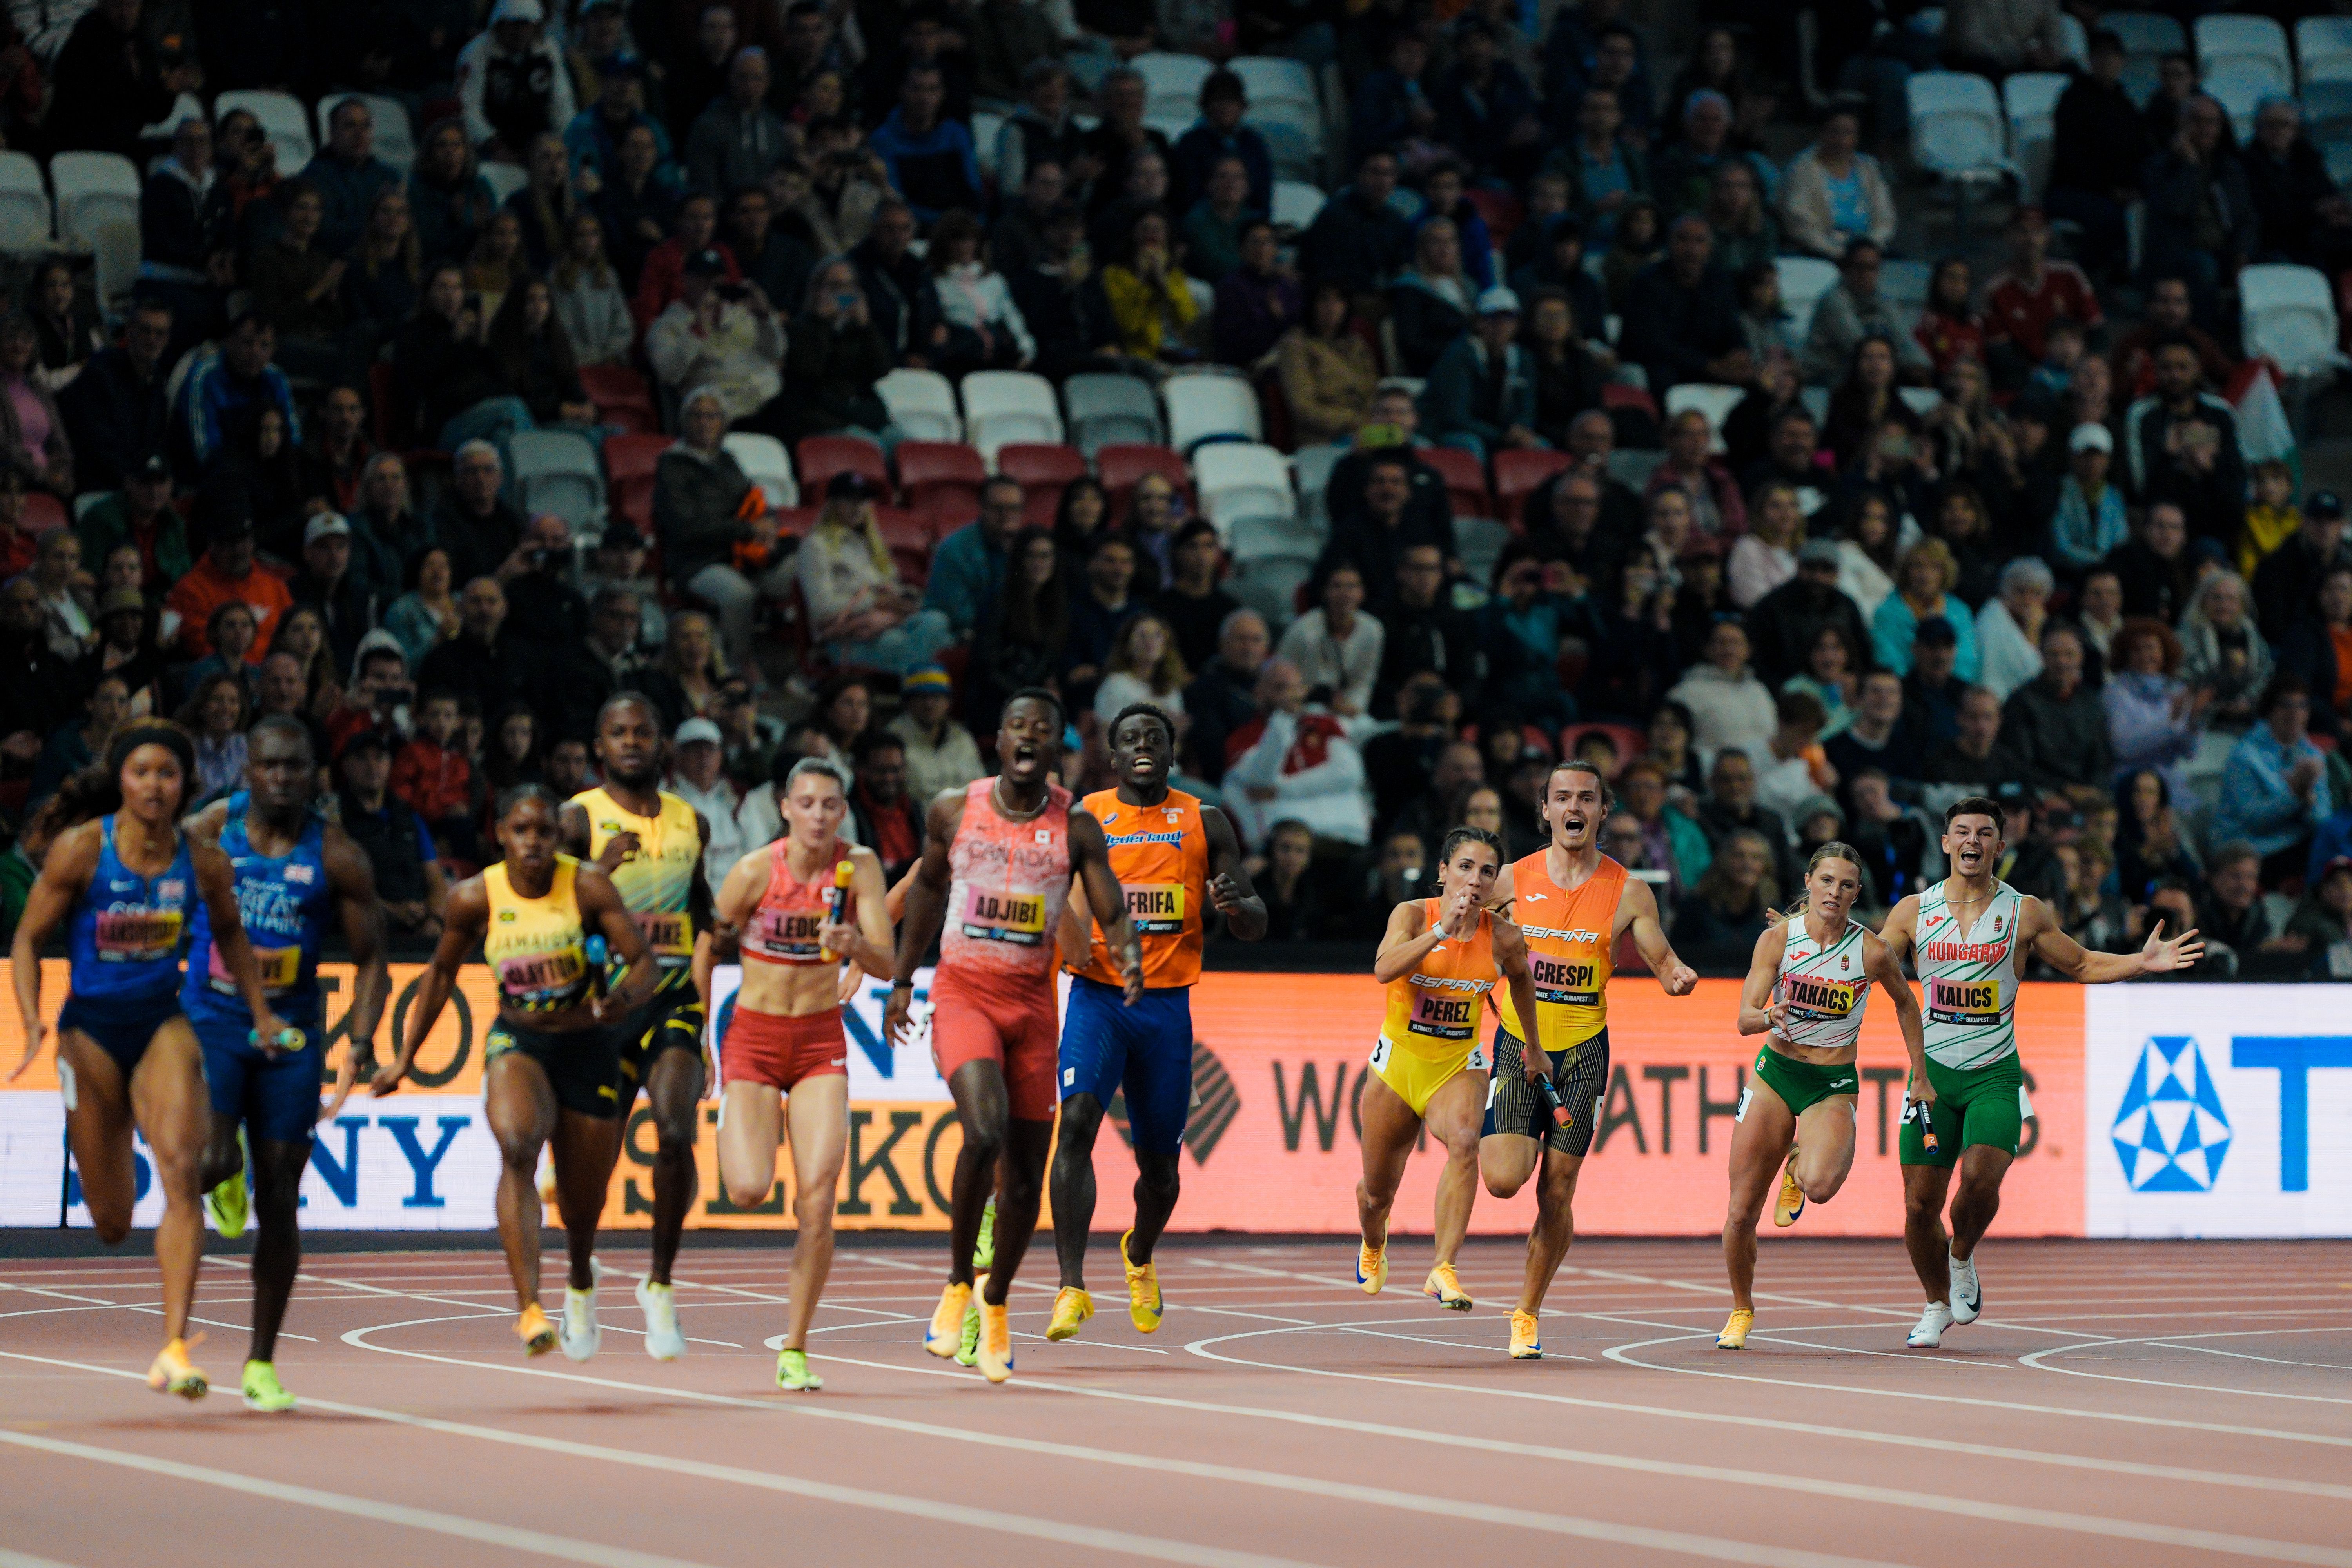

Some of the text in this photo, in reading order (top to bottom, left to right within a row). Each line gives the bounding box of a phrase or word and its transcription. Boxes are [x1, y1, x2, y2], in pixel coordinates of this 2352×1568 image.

[976, 895, 1037, 924] ADJIBI
[1127, 891, 1174, 913] FRIFA
[775, 915, 821, 937] LEDU
[1522, 924, 1599, 944] ESPAÑA
[1928, 941, 2002, 963] HUNGARY
[1409, 973, 1495, 993] ESPAÑA
[1533, 960, 1593, 987] CRESPI
[1535, 991, 1548, 999] MATE
[1791, 980, 1849, 1011] TAKÁCS
[1937, 984, 1992, 1008] KALICS
[1933, 1012, 1951, 1021] ULTIMATE
[1373, 1039, 1382, 1062] 3
[1921, 1104, 1931, 1123] MONDO
